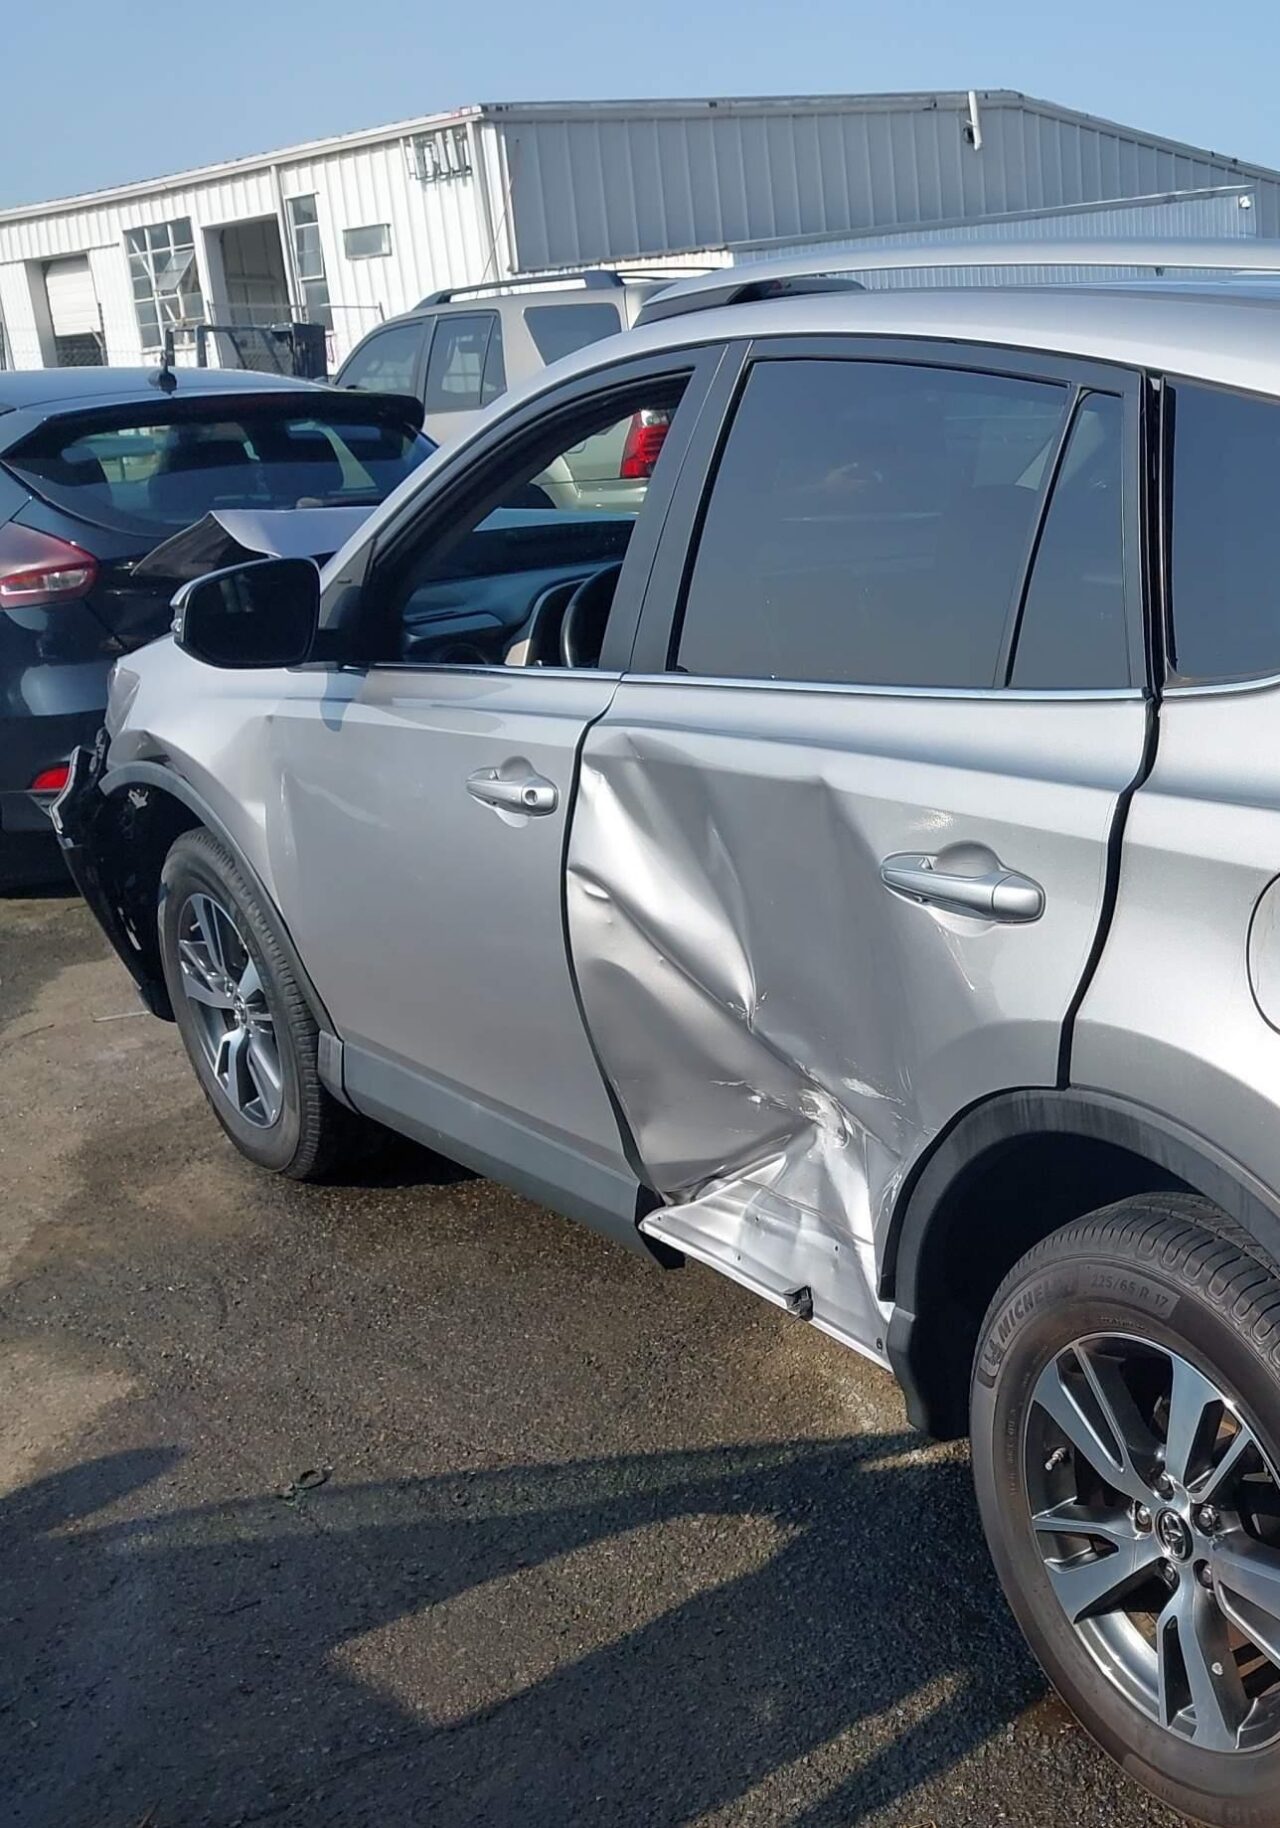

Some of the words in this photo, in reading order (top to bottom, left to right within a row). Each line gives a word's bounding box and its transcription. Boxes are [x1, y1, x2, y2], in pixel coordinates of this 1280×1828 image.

[997, 1273, 1076, 1344] MICHEL
[1139, 1285, 1150, 1298] R
[1155, 1293, 1169, 1307] 17
